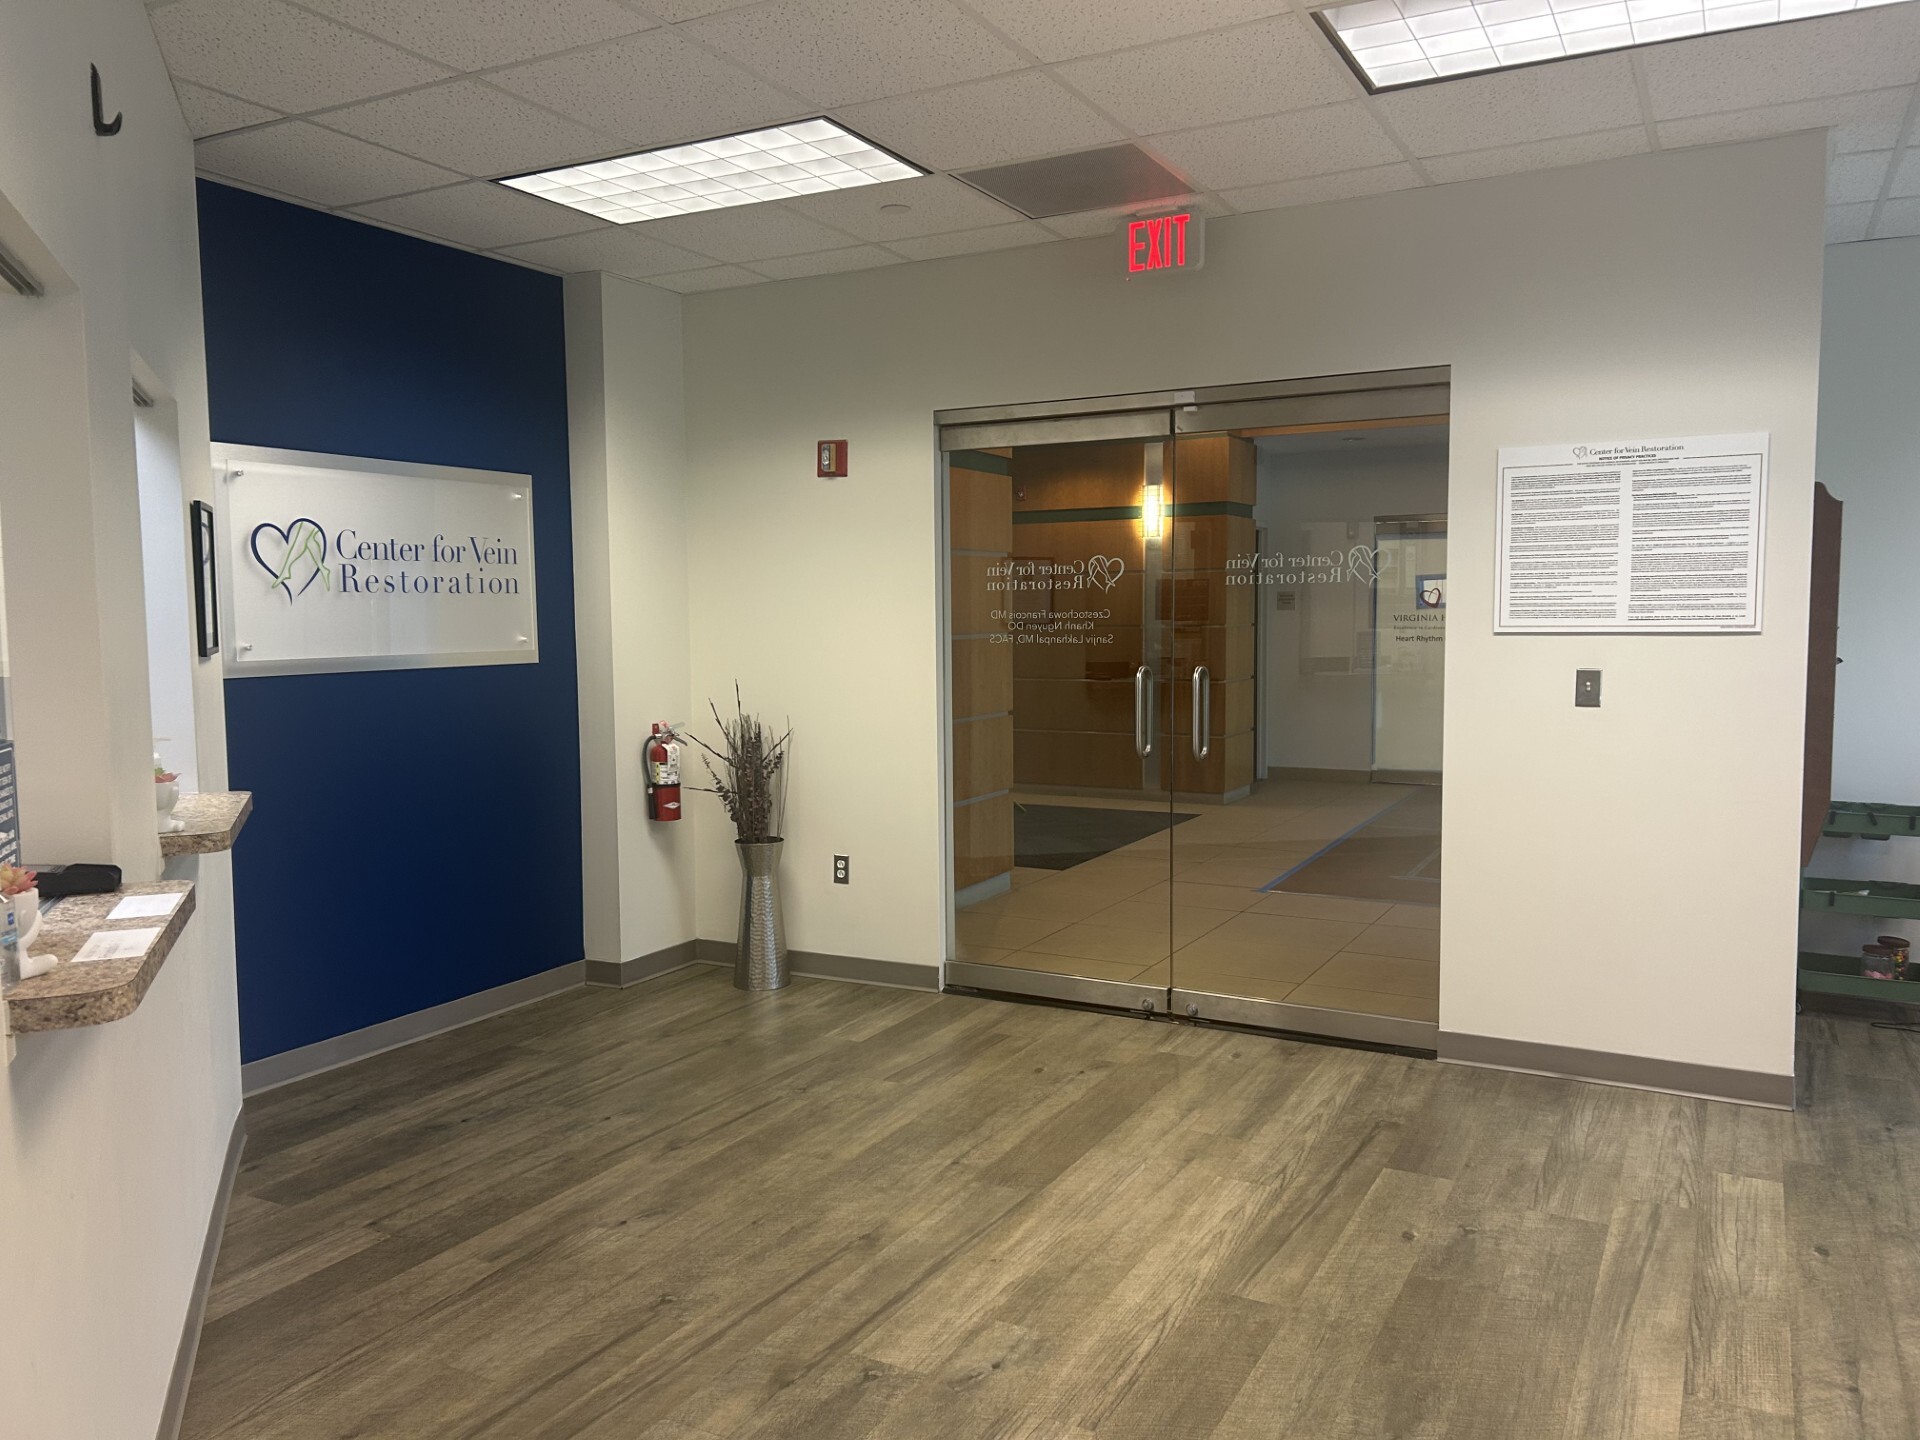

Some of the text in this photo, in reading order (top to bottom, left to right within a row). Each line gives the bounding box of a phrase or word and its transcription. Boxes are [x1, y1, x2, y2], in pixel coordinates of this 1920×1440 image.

[1128, 213, 1190, 273] EXIT
[1589, 448, 1612, 456] Center
[1641, 444, 1684, 452] Restoration
[336, 529, 518, 565] Center for Vein
[338, 563, 520, 594] Restoration
[1393, 614, 1438, 622] VIRGINIA
[1416, 635, 1443, 643] Rhythm
